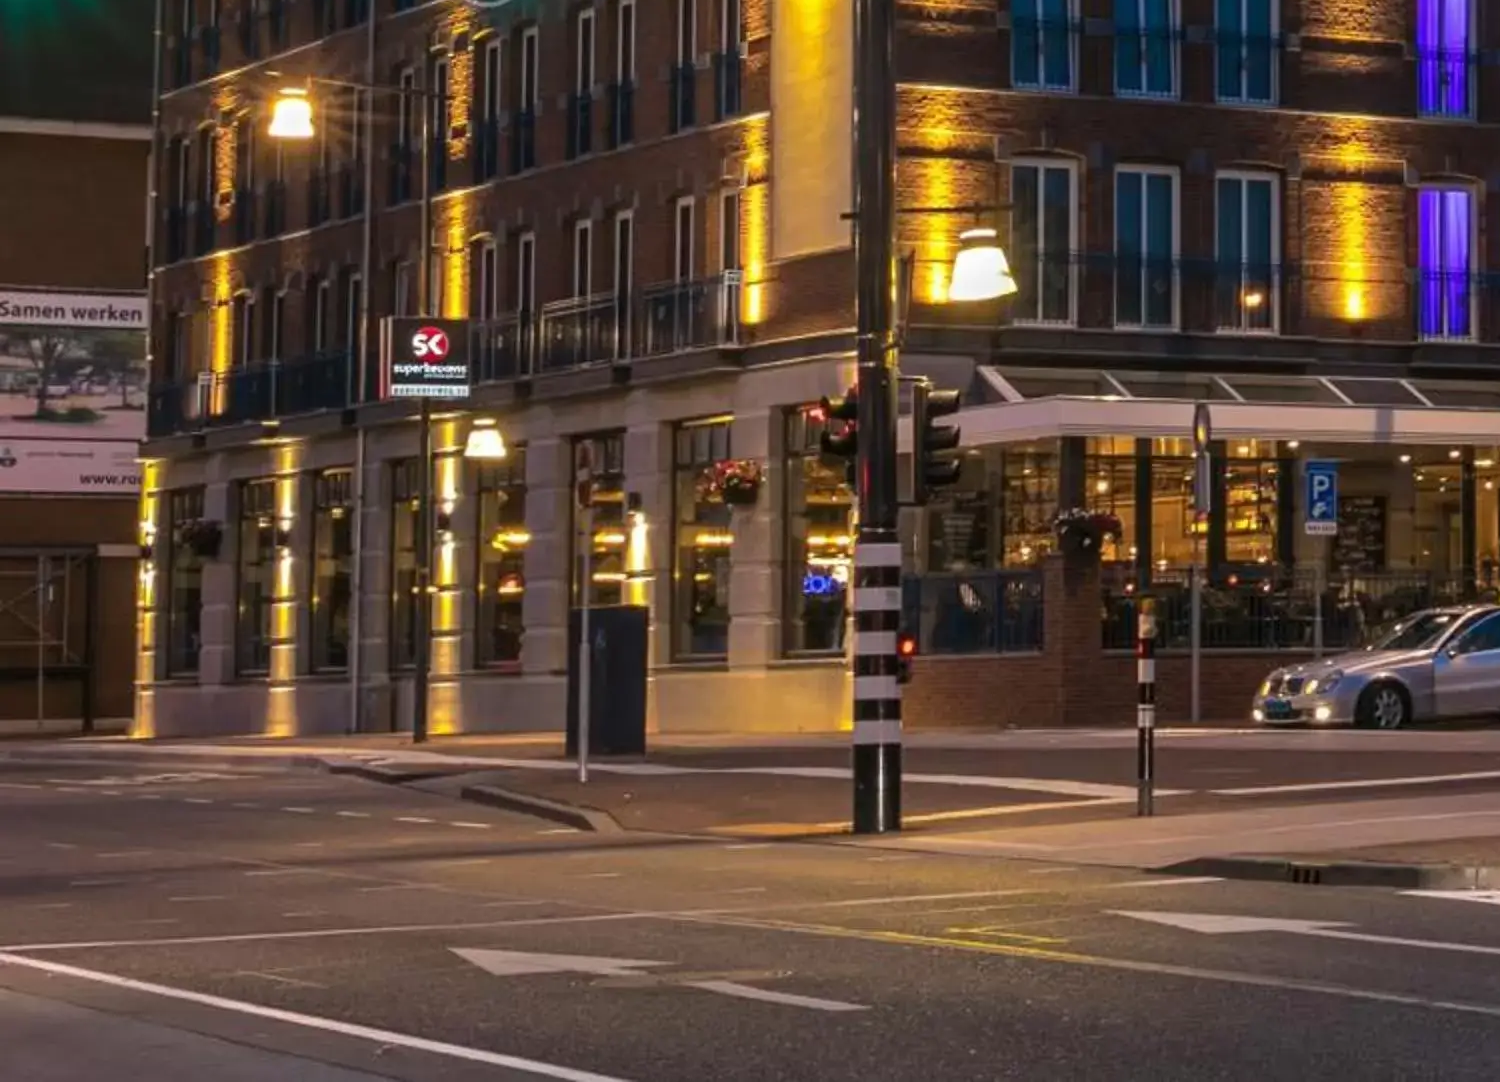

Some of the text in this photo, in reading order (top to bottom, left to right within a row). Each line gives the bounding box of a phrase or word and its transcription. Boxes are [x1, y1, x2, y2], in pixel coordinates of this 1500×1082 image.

[0, 300, 143, 322] Samen werken
[1312, 475, 1330, 500] P
